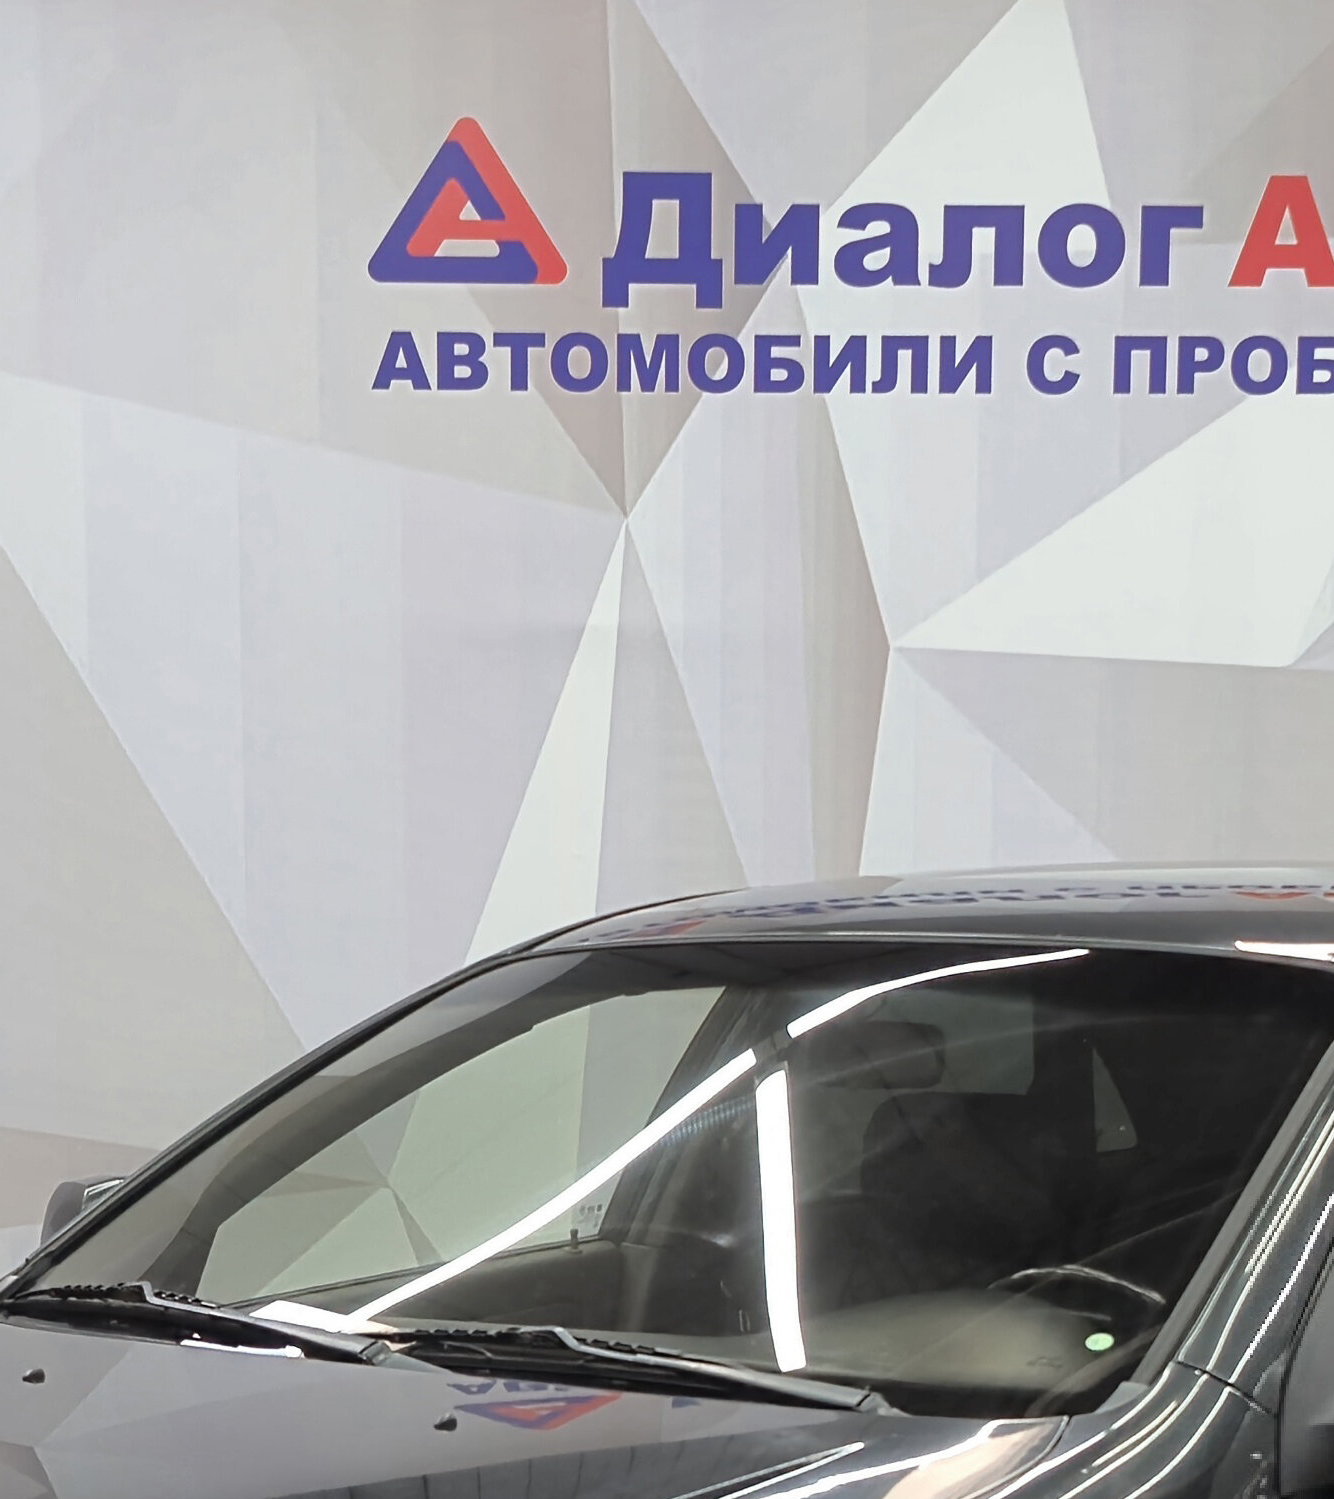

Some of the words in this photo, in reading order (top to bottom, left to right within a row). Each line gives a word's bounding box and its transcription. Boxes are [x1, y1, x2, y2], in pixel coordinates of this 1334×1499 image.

[602, 171, 1203, 309] Диалог
[373, 331, 993, 394] АВТОМОБИЛИ
[1028, 335, 1080, 394] С
